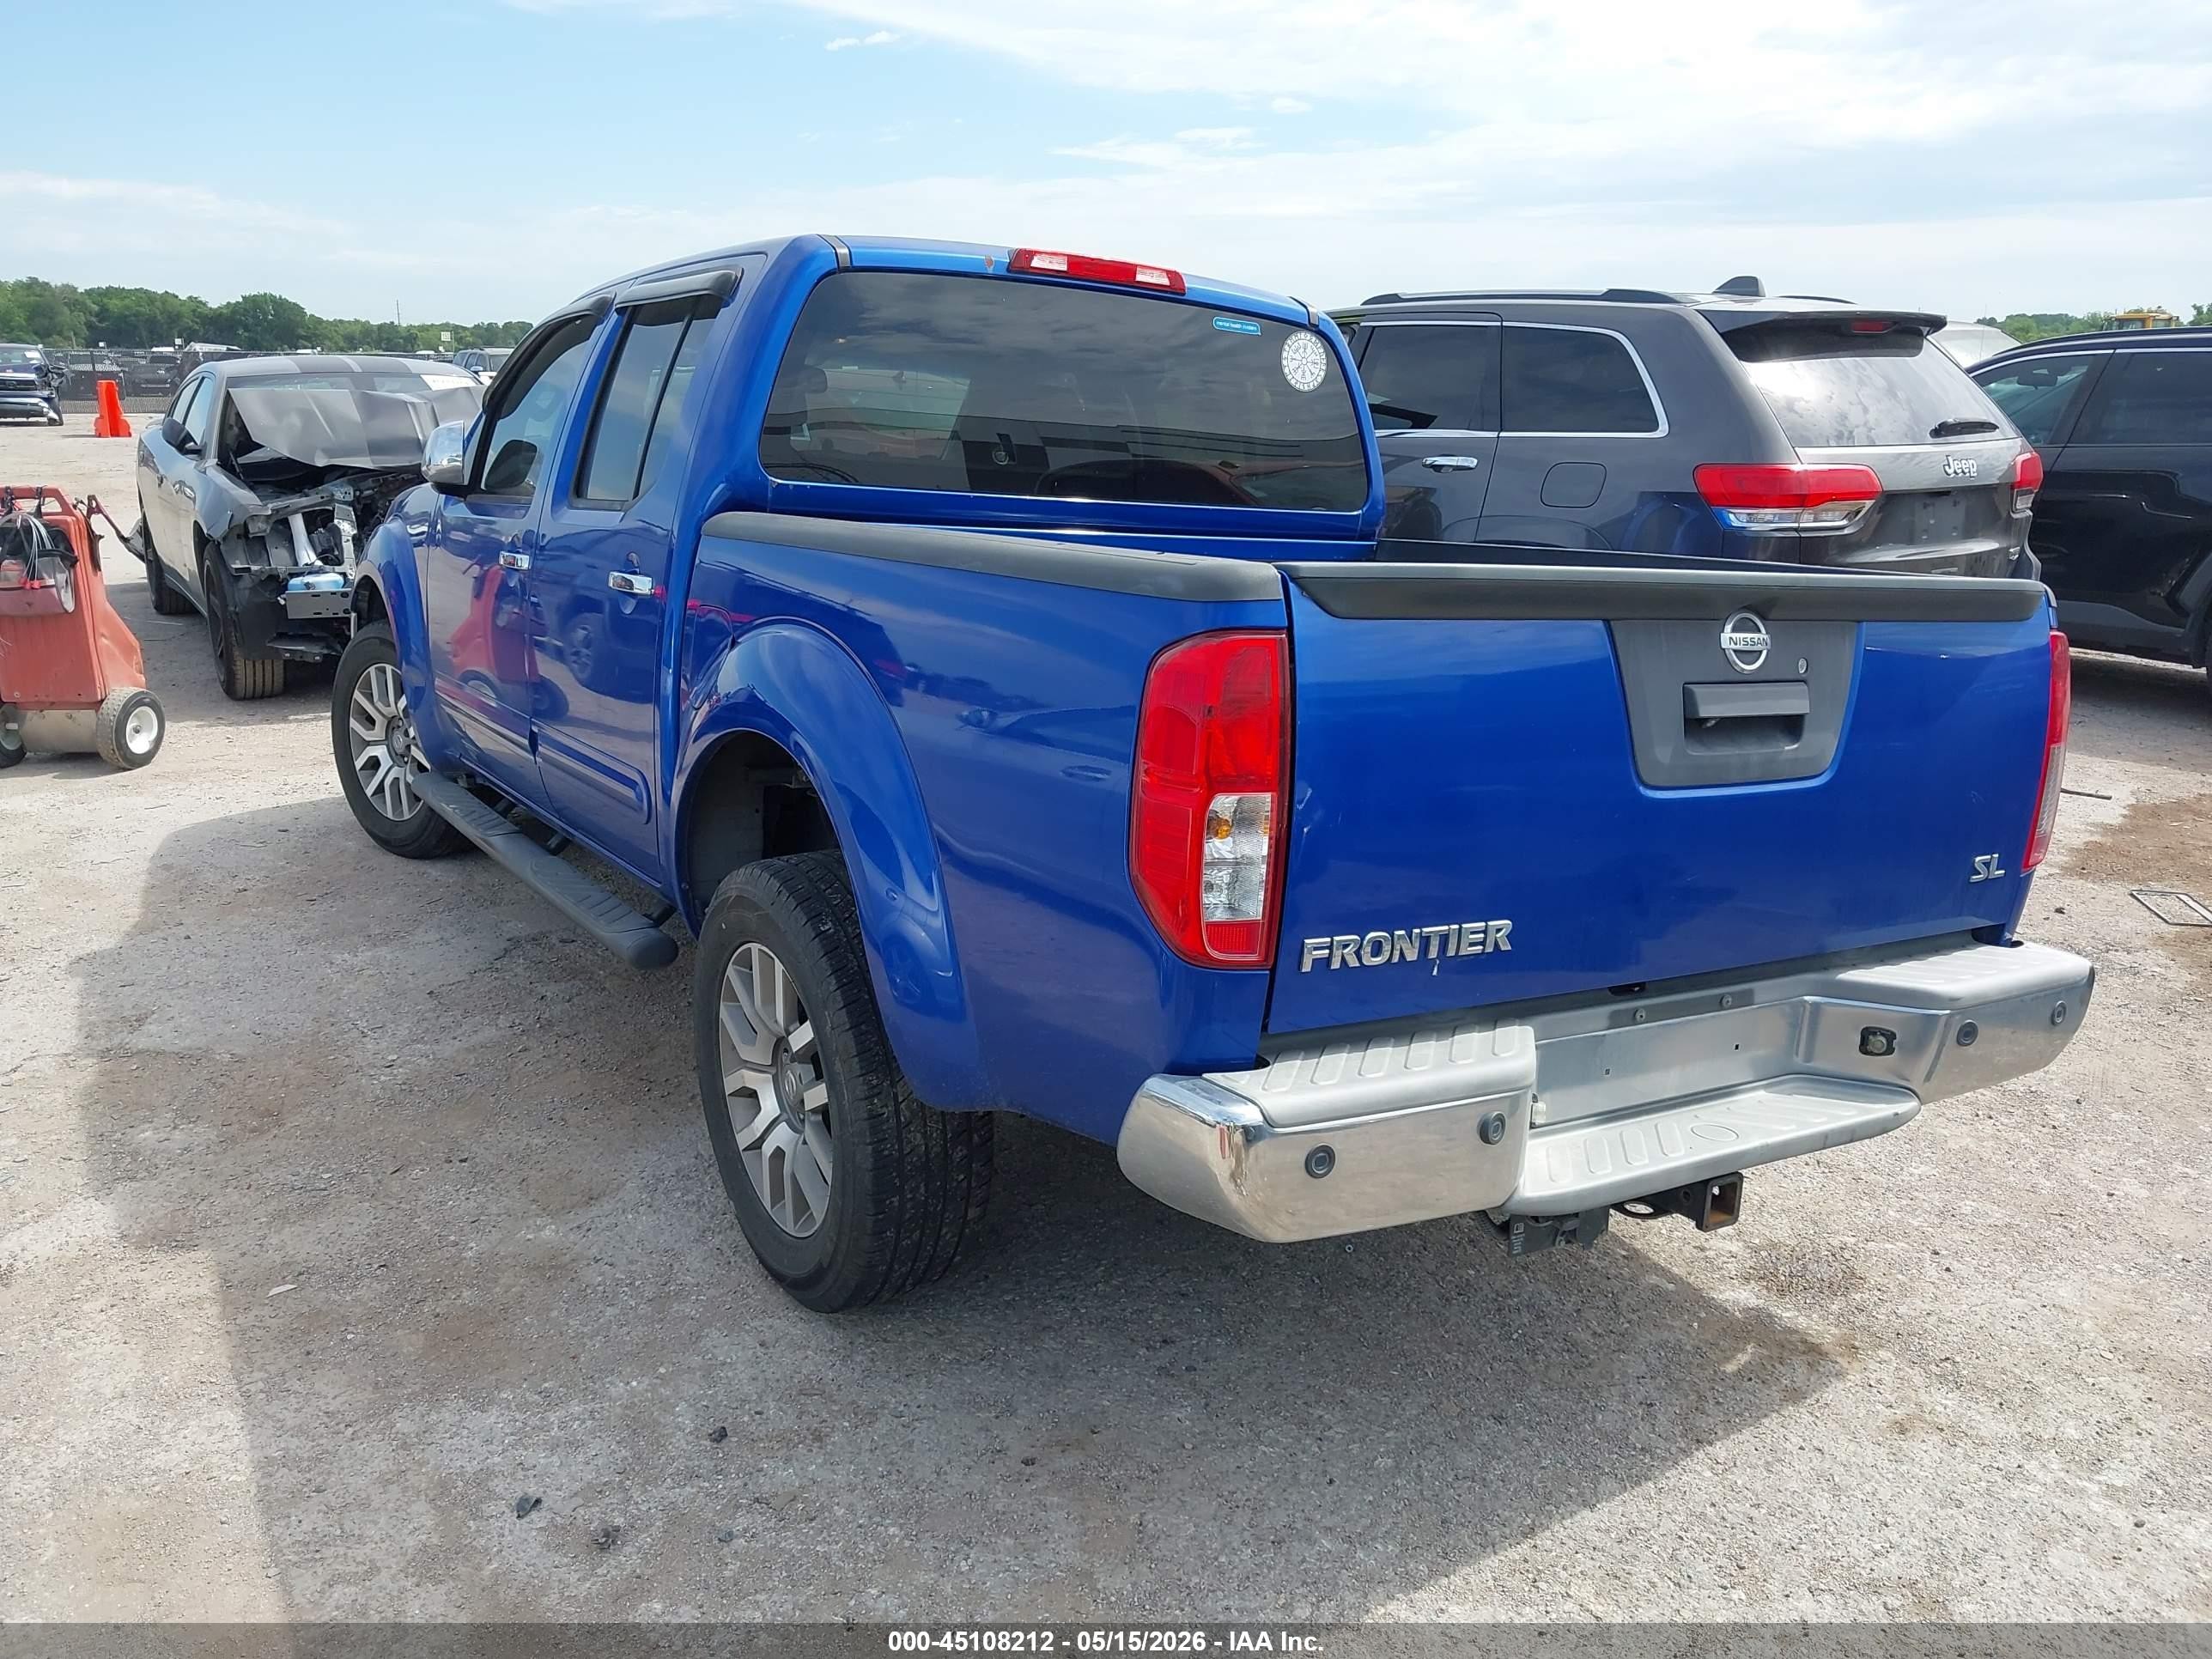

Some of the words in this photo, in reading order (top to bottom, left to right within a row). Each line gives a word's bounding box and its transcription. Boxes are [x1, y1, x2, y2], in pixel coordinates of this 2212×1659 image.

[1943, 455, 1978, 479] Jeep
[1729, 636, 1768, 647] NISSAN
[1969, 854, 2006, 882] SL
[1299, 920, 1512, 972] FRONTIER
